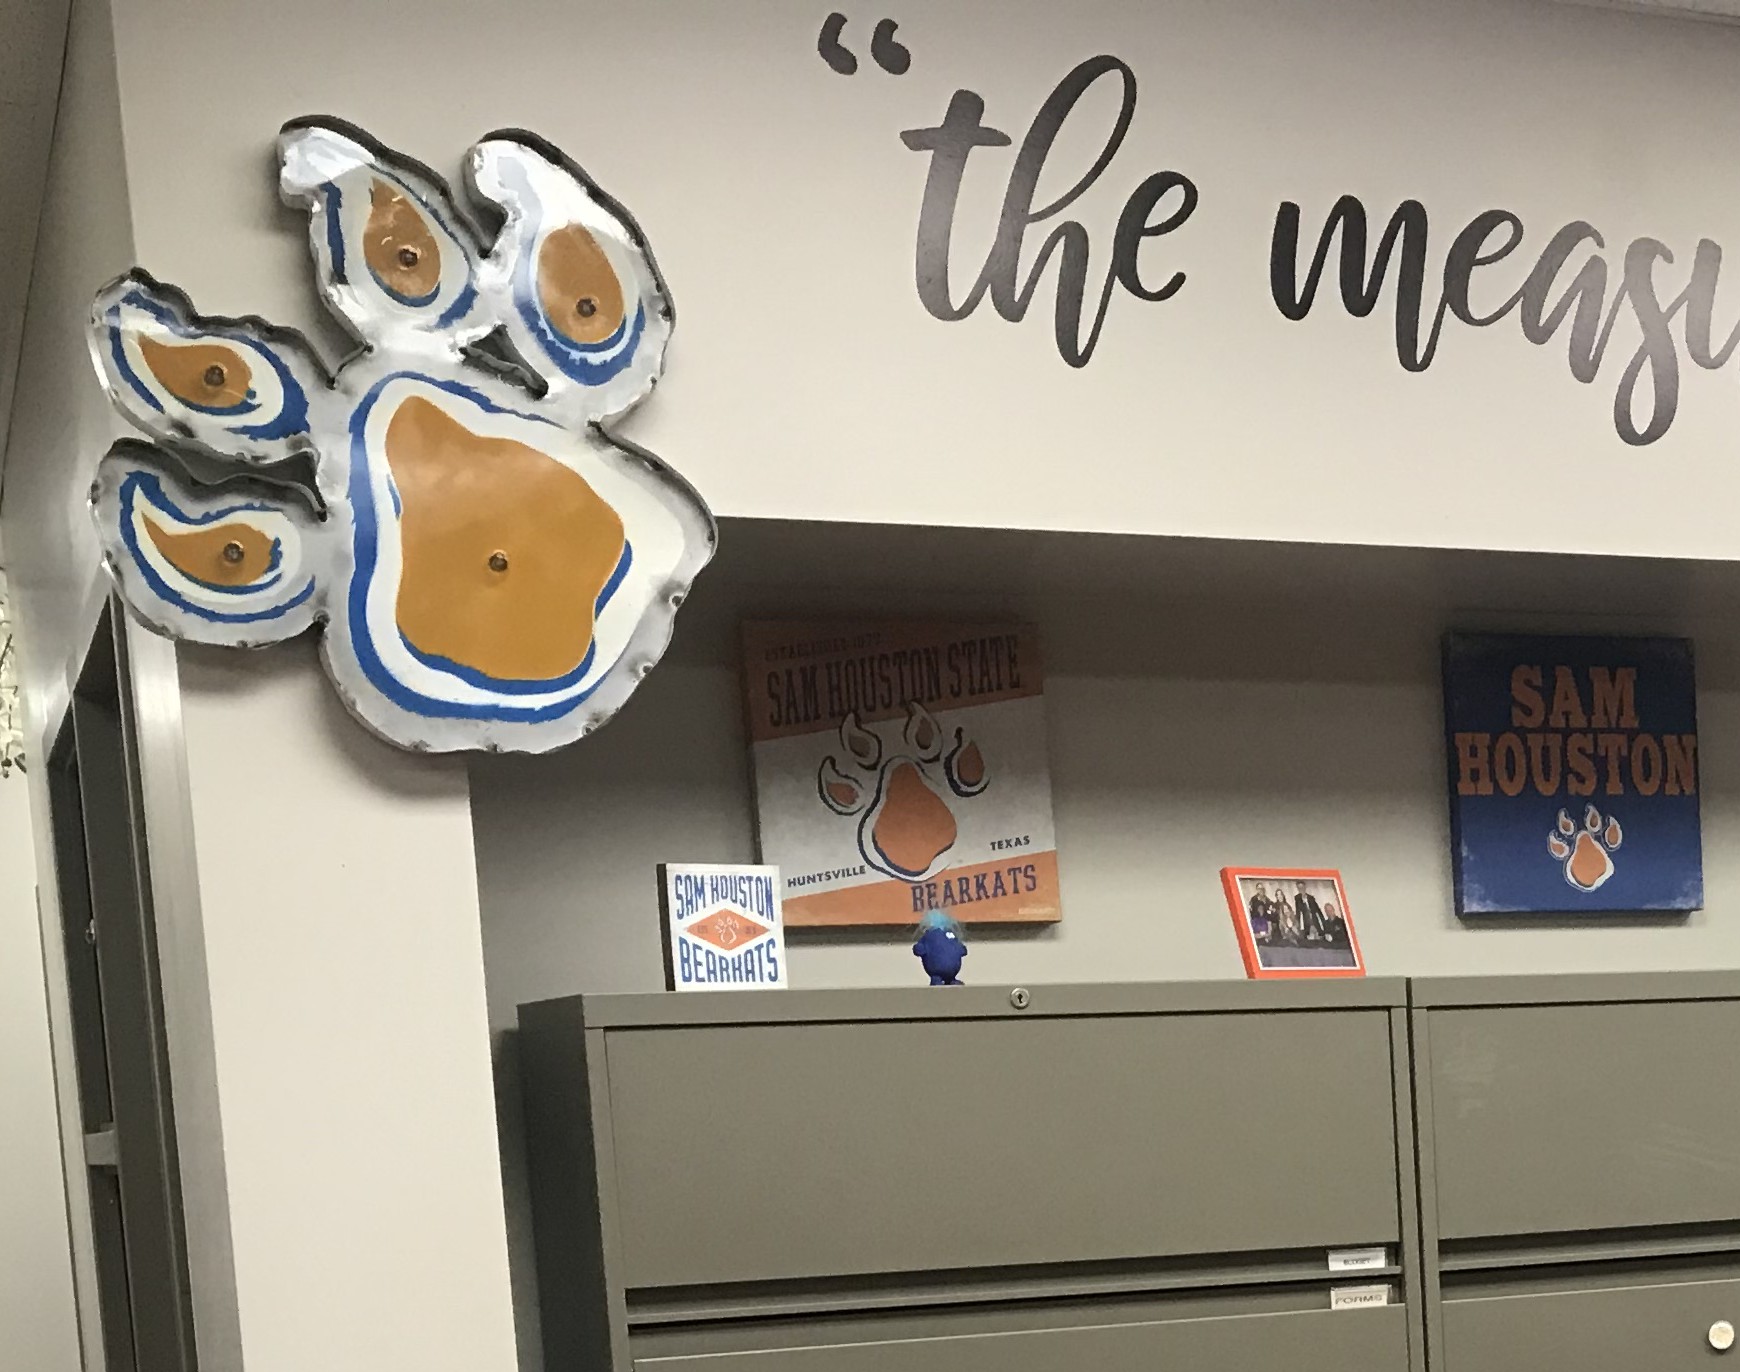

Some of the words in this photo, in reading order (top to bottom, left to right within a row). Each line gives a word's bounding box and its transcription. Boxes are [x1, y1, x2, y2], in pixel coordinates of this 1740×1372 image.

[767, 664, 822, 727] SAM
[825, 646, 942, 717] HOUSTON
[947, 634, 1021, 698] STATE
[1511, 664, 1640, 729] SAM
[1454, 732, 1699, 797] HOUSTON
[989, 835, 1031, 852] TEXAS
[675, 873, 707, 921] SAM
[709, 873, 775, 922] HOUSTON
[787, 864, 867, 889] HUNTSVILLE
[910, 863, 1037, 913] BEARKATS
[678, 935, 780, 983] BEARKATS
